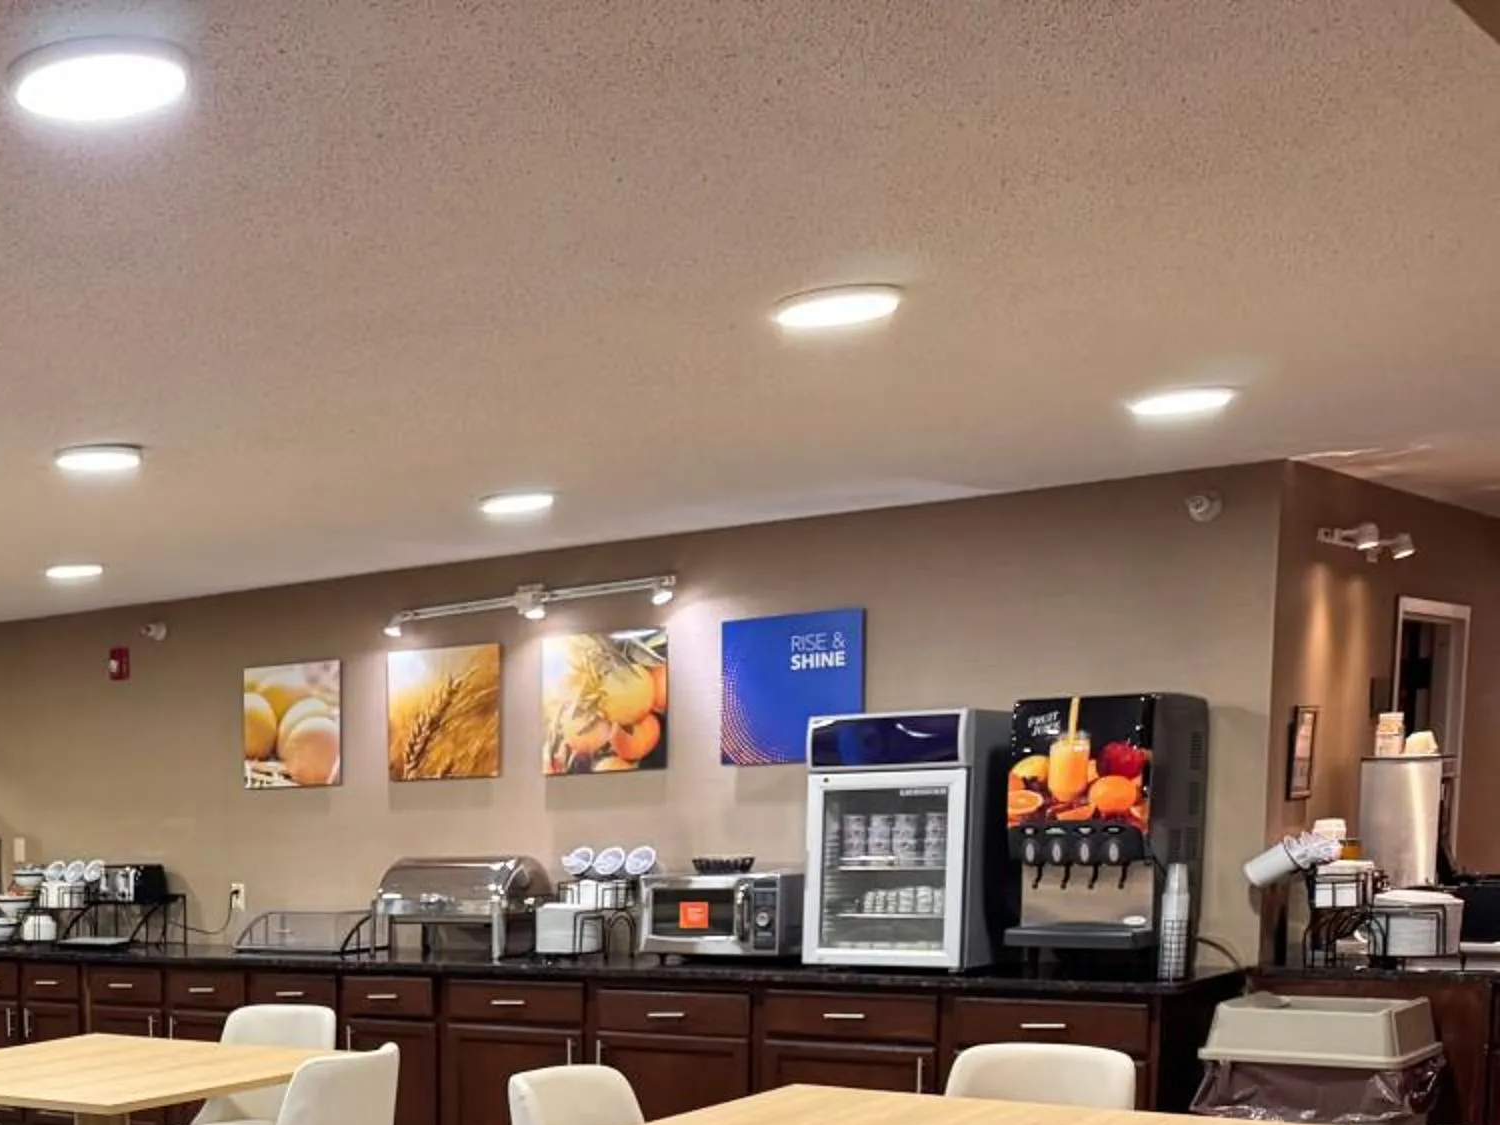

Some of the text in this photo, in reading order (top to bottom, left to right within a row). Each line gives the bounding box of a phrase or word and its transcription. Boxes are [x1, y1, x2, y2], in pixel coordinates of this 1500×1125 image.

[791, 631, 846, 652] RISE &
[790, 650, 845, 671] SHINE
[1027, 710, 1060, 728] FRUIT
